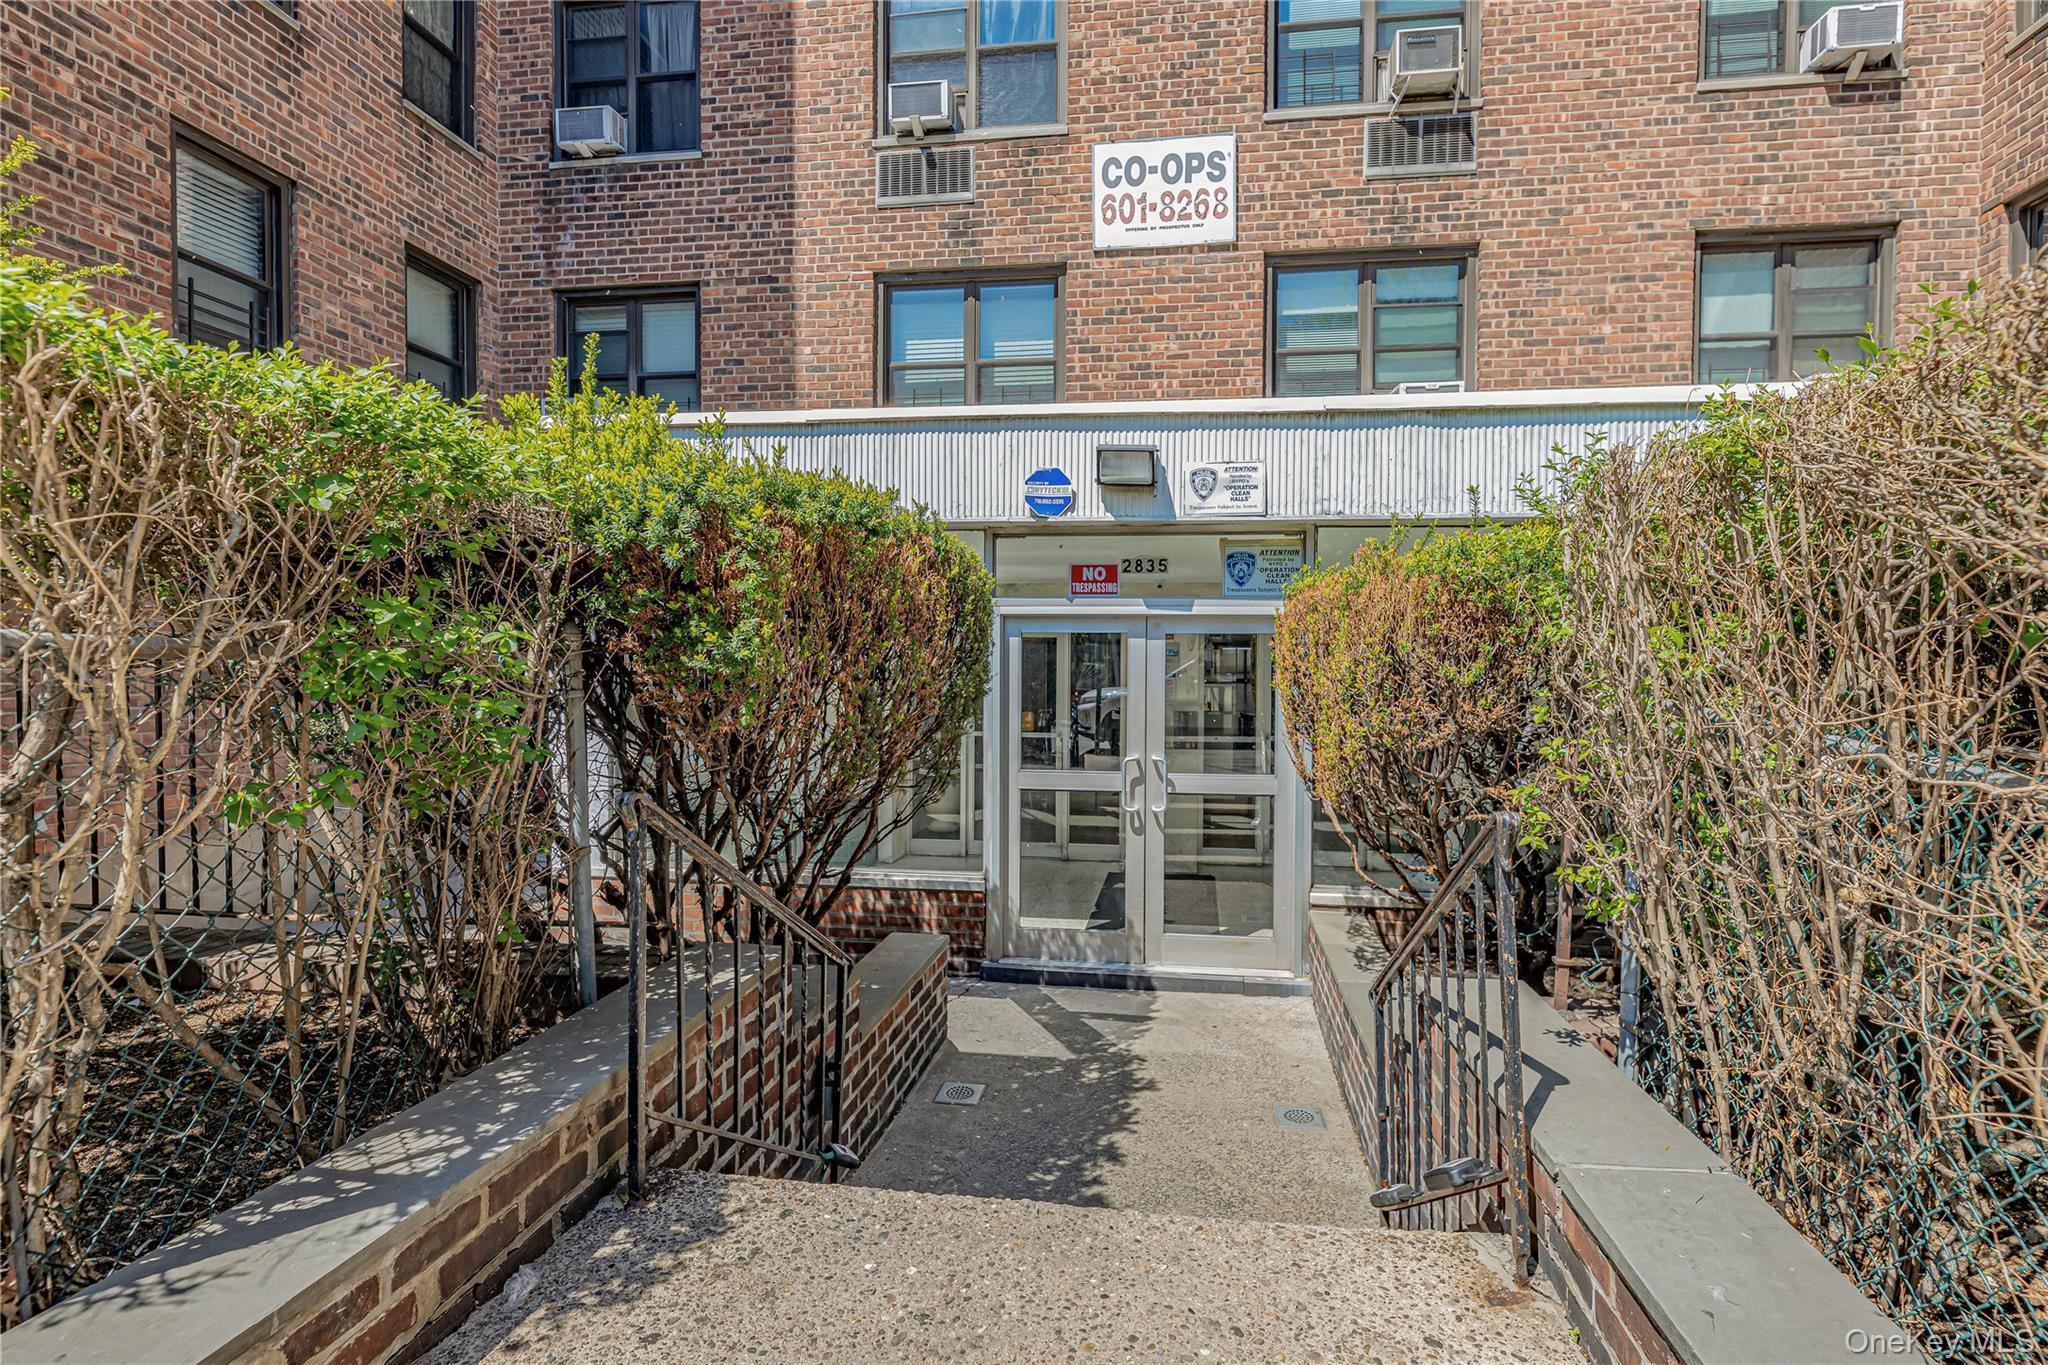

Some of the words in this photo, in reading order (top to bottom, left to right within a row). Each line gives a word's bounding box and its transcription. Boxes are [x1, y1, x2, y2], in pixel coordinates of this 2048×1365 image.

[1101, 150, 1227, 189] CO-OPS
[1101, 186, 1229, 226] 601-8268
[1082, 566, 1107, 581] NO
[1122, 559, 1168, 573] 2835
[1072, 582, 1118, 593] TRESPASSING
